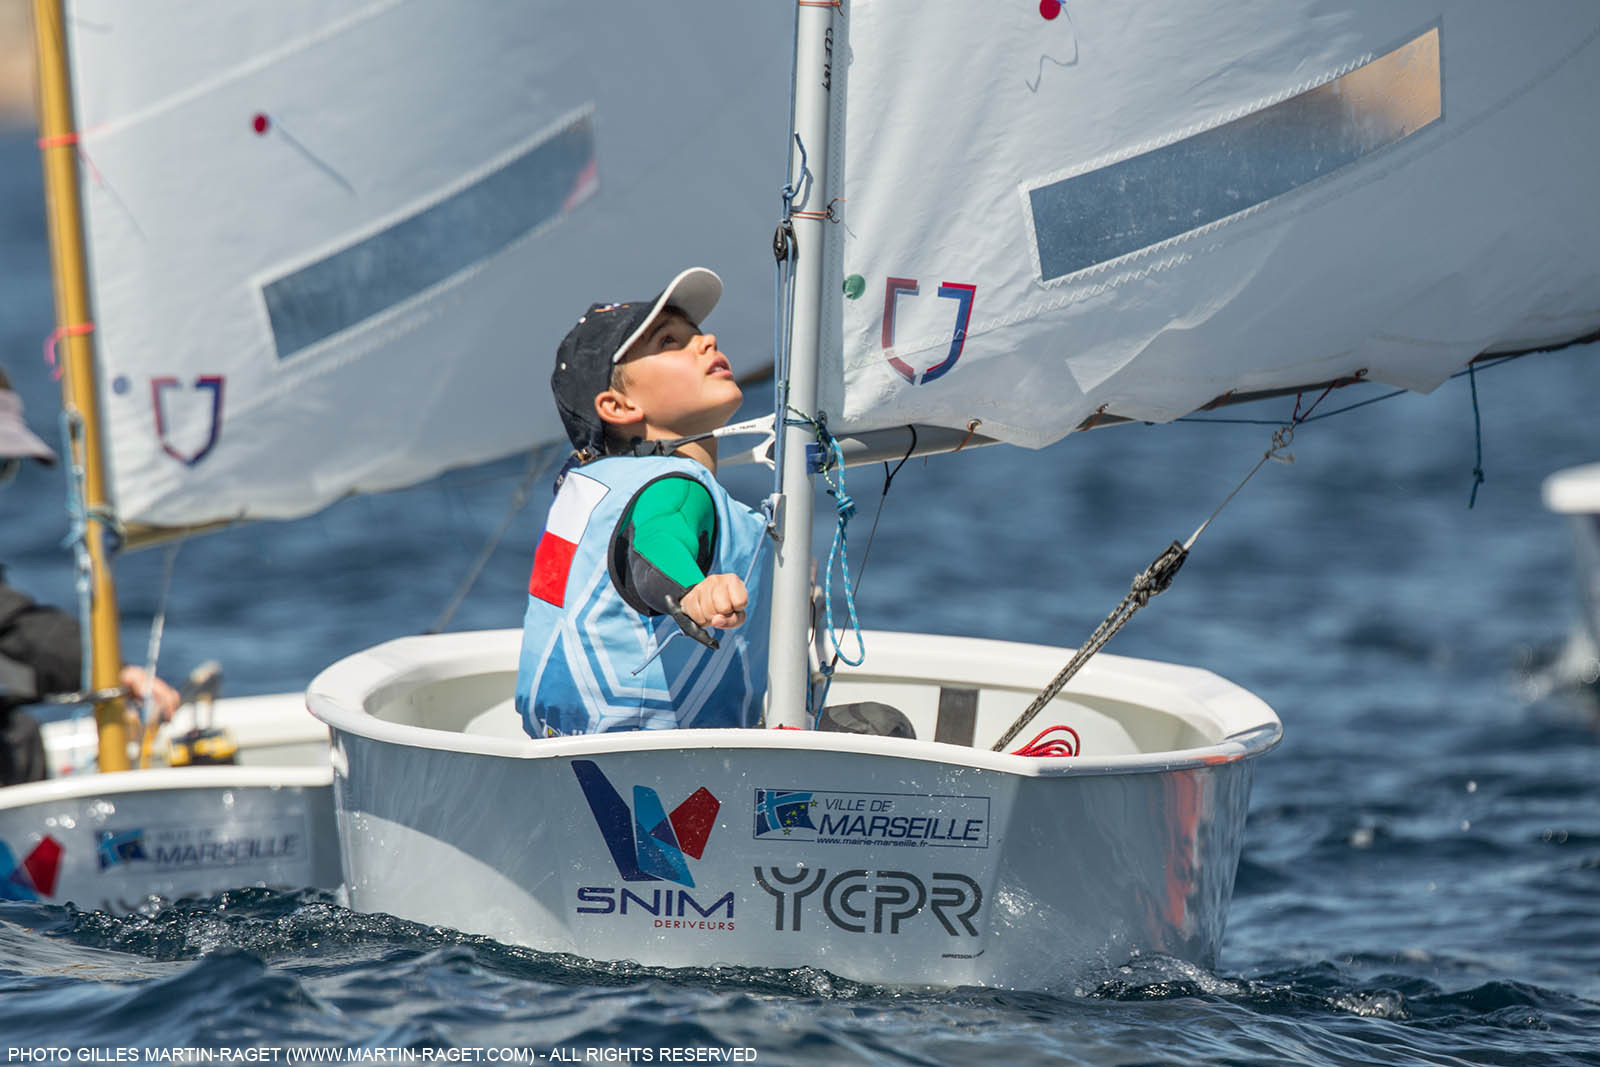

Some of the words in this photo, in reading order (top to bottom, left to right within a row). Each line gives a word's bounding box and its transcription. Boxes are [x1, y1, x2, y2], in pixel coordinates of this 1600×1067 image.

[825, 798, 867, 811] VILLE
[870, 800, 893, 813] DE
[818, 814, 984, 842] MARSEILLE
[816, 837, 929, 848] www.mairie-marseille.fr
[576, 887, 735, 919] SNIM
[753, 866, 984, 937] YCPR
[653, 919, 736, 931] DERIVEURS
